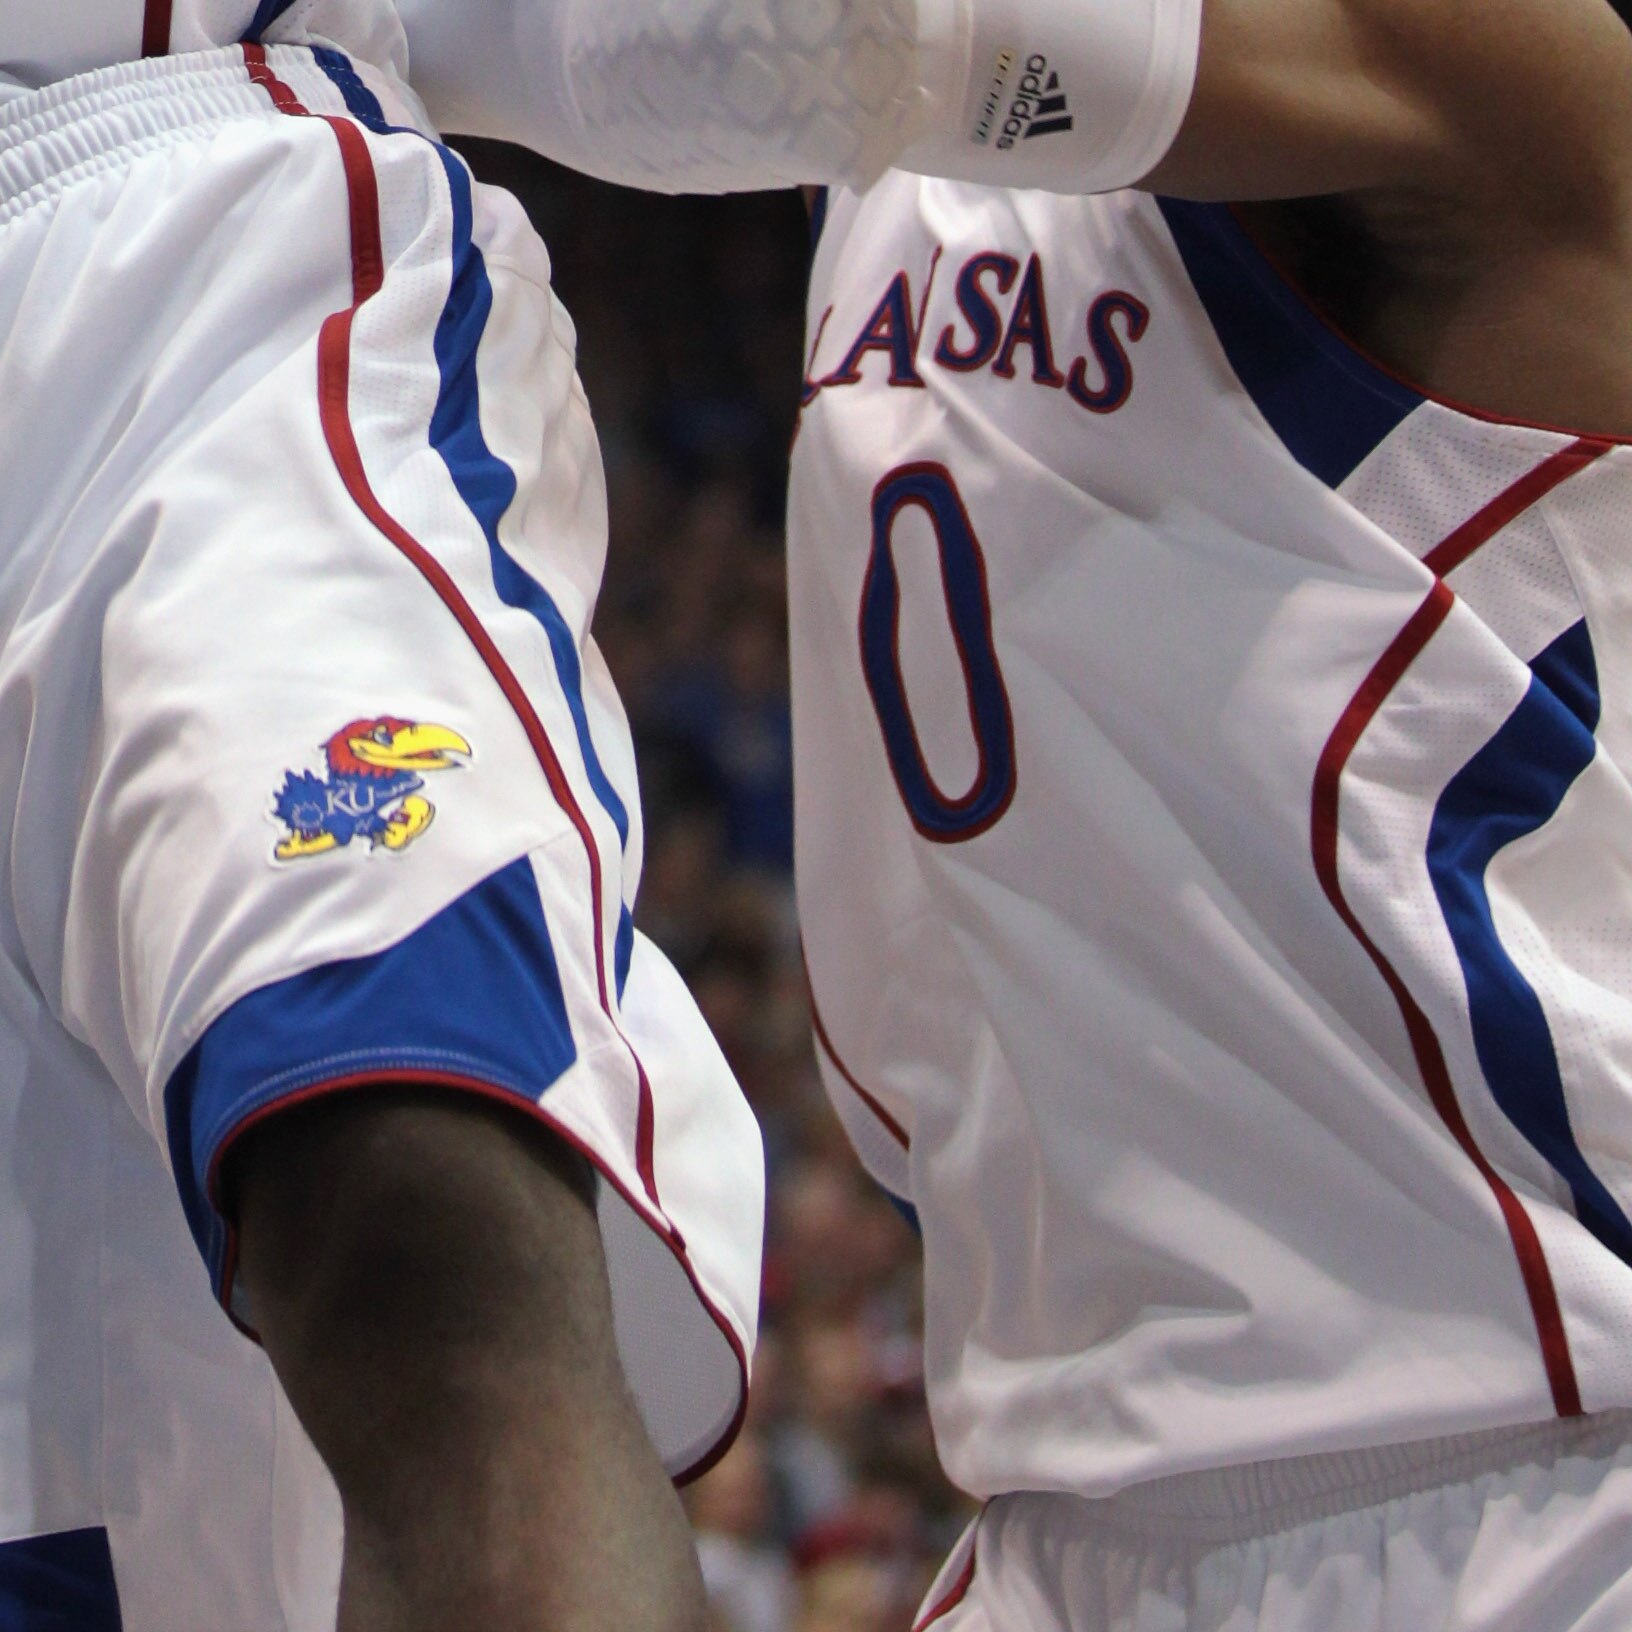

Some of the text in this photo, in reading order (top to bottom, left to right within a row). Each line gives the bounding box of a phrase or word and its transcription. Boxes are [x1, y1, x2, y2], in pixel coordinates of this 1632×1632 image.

[996, 53, 1047, 150] adidas
[858, 460, 1018, 844] 0
[324, 783, 375, 817] KU
